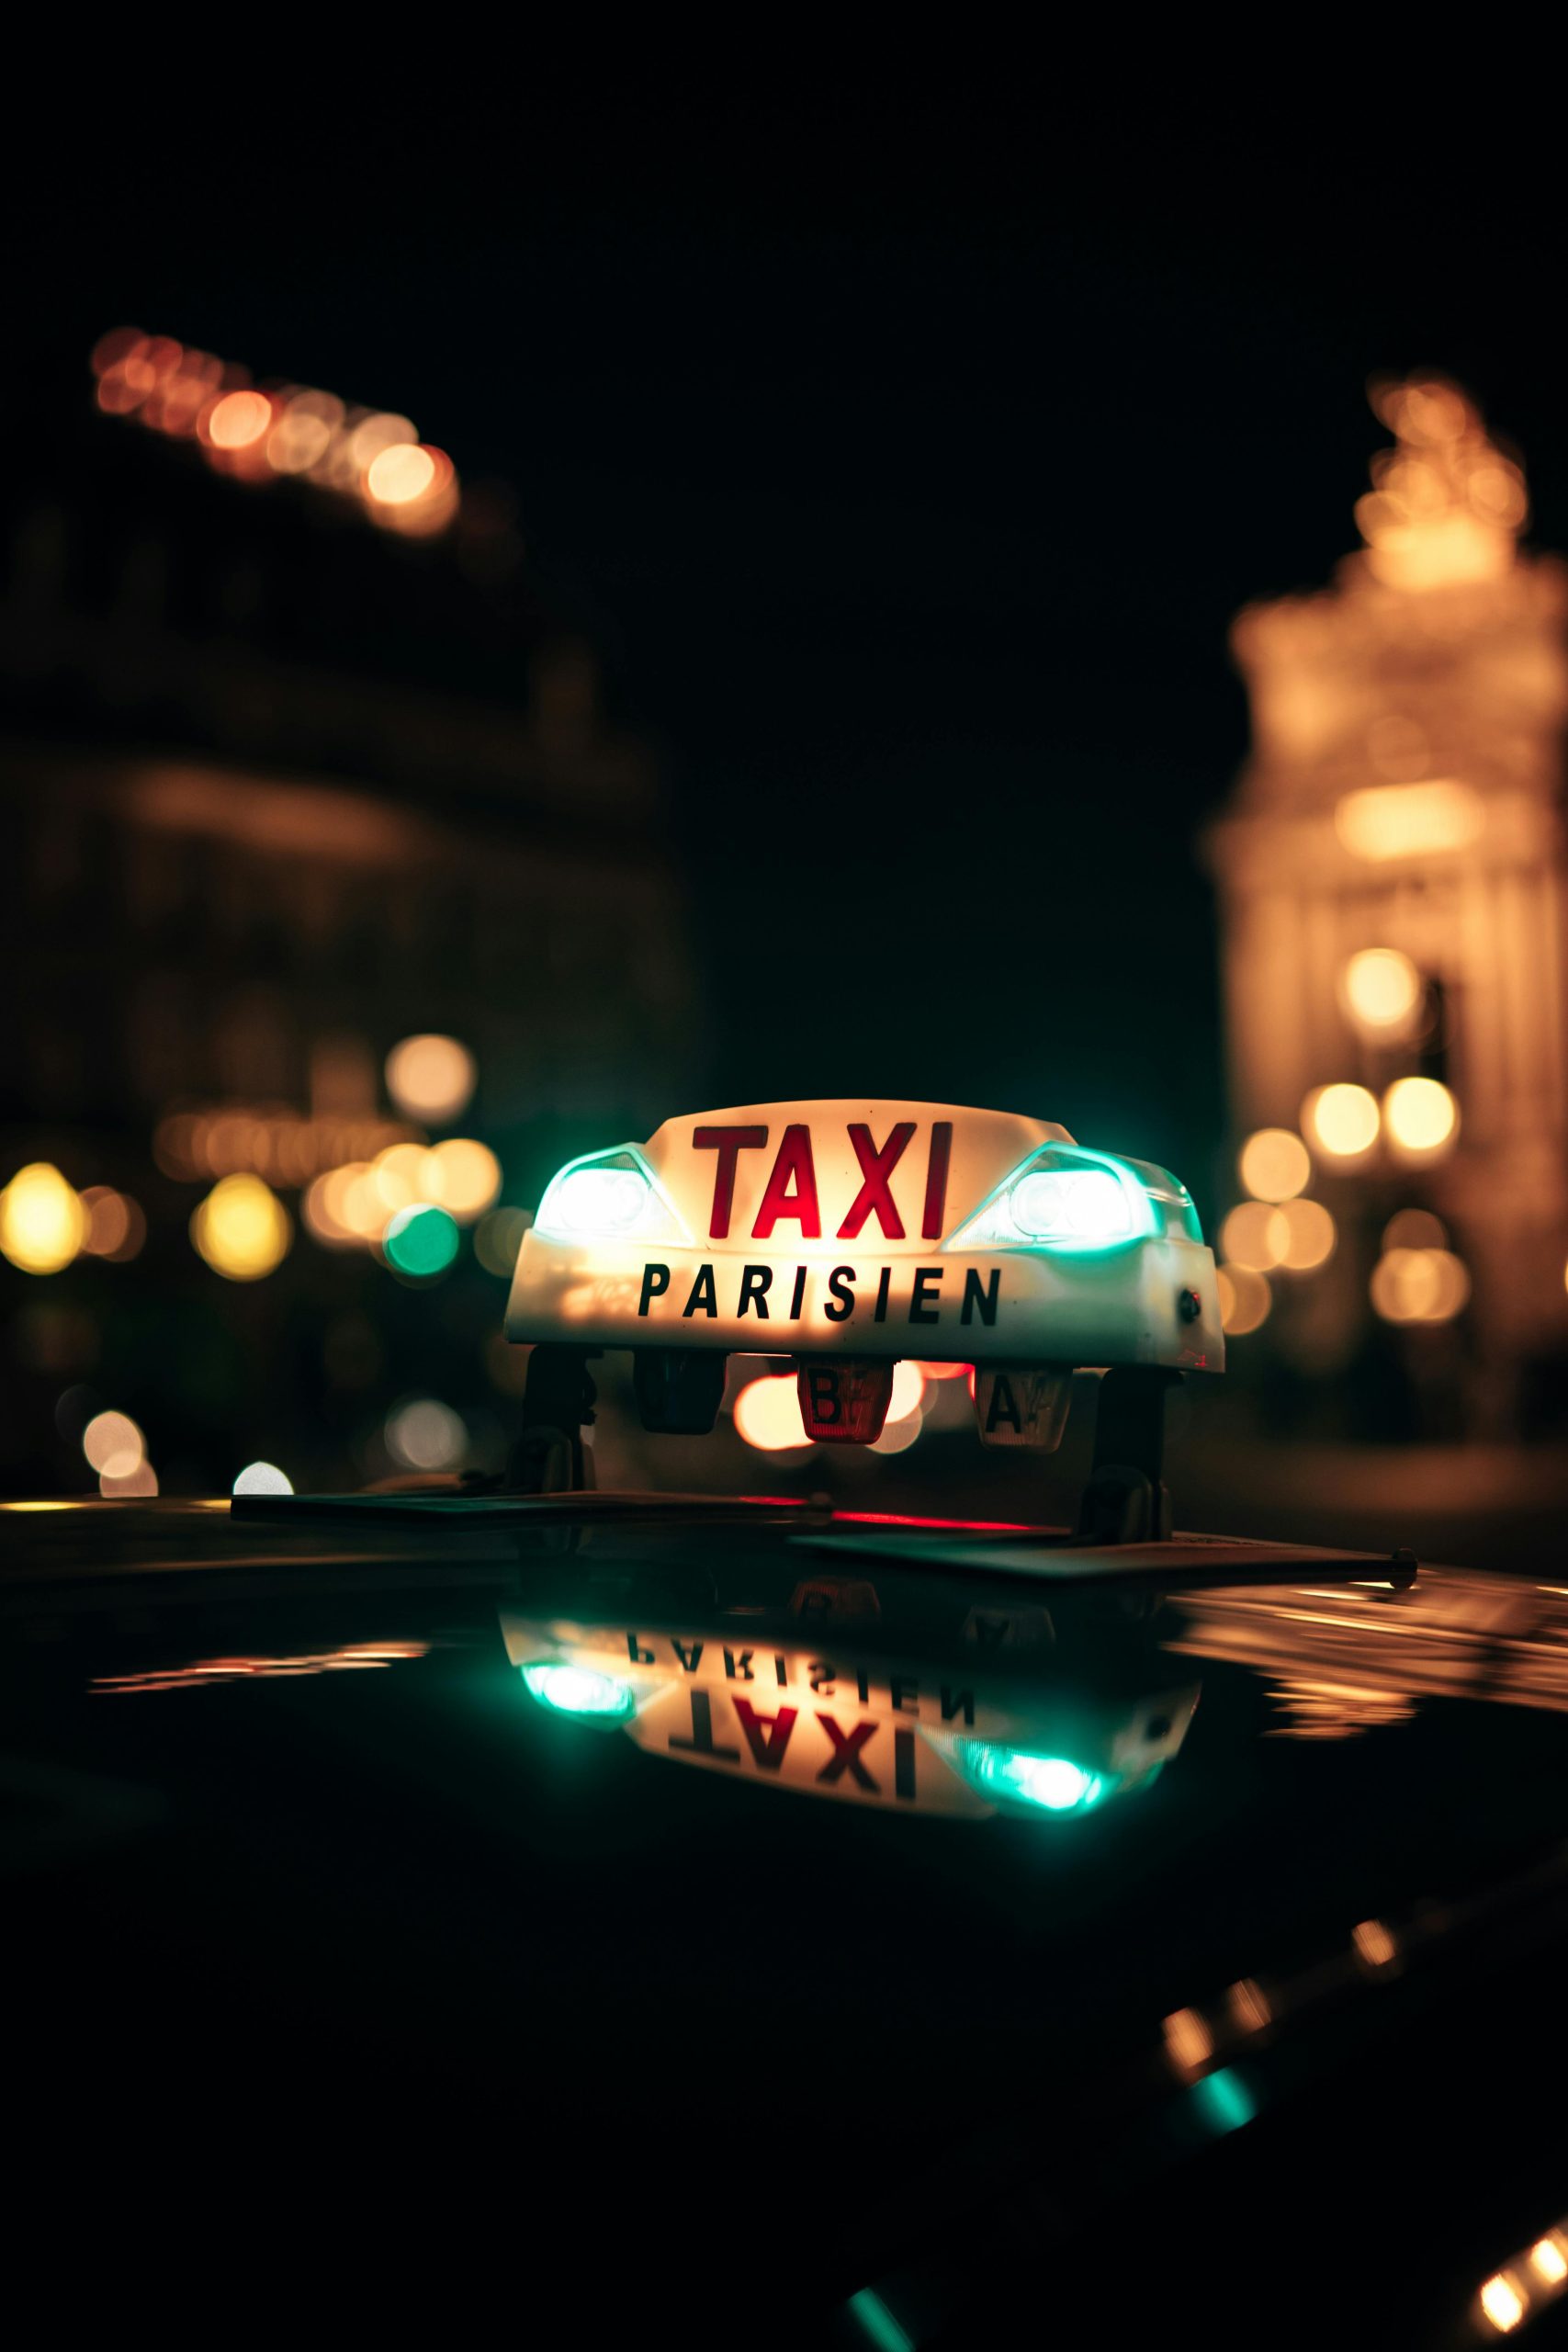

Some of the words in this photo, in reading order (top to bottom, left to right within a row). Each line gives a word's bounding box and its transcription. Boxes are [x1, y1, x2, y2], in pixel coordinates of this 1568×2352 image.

[693, 1123, 953, 1240] TAXI
[637, 1263, 1001, 1326] PARISIEN
[808, 1368, 841, 1423] B
[986, 1375, 1021, 1433] A
